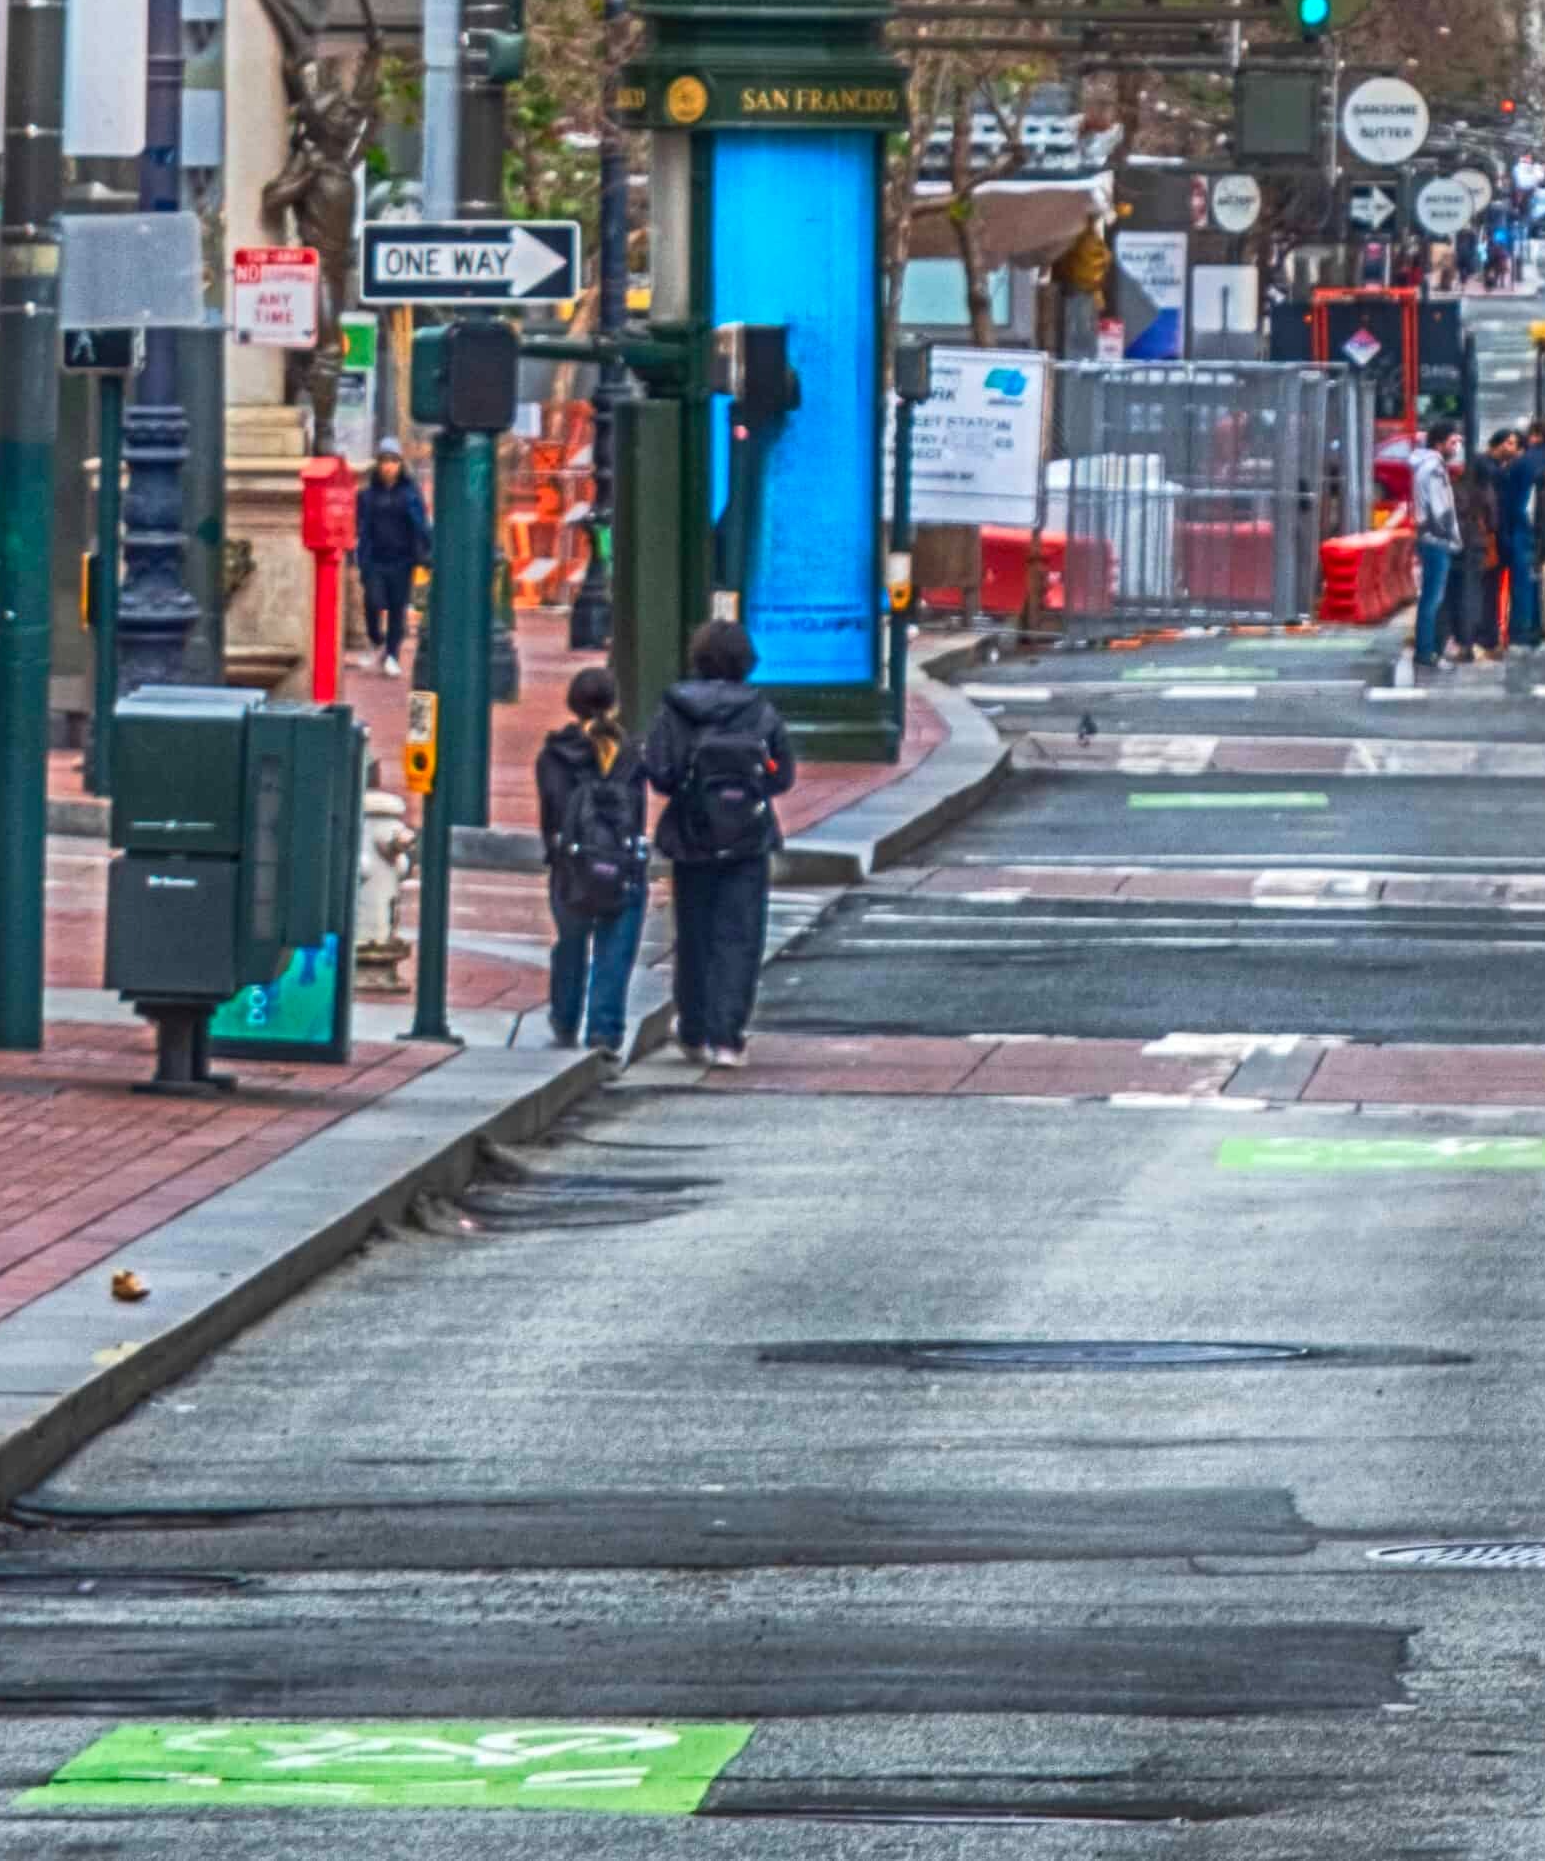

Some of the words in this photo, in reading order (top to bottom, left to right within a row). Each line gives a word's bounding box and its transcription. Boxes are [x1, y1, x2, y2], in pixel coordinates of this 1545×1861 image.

[741, 87, 789, 112] SAN
[1352, 104, 1417, 116] SANSOME
[386, 248, 441, 276] ONE
[453, 248, 511, 276] WAY
[236, 264, 261, 281] NO
[258, 293, 293, 307] ANY
[255, 310, 295, 324] TIME
